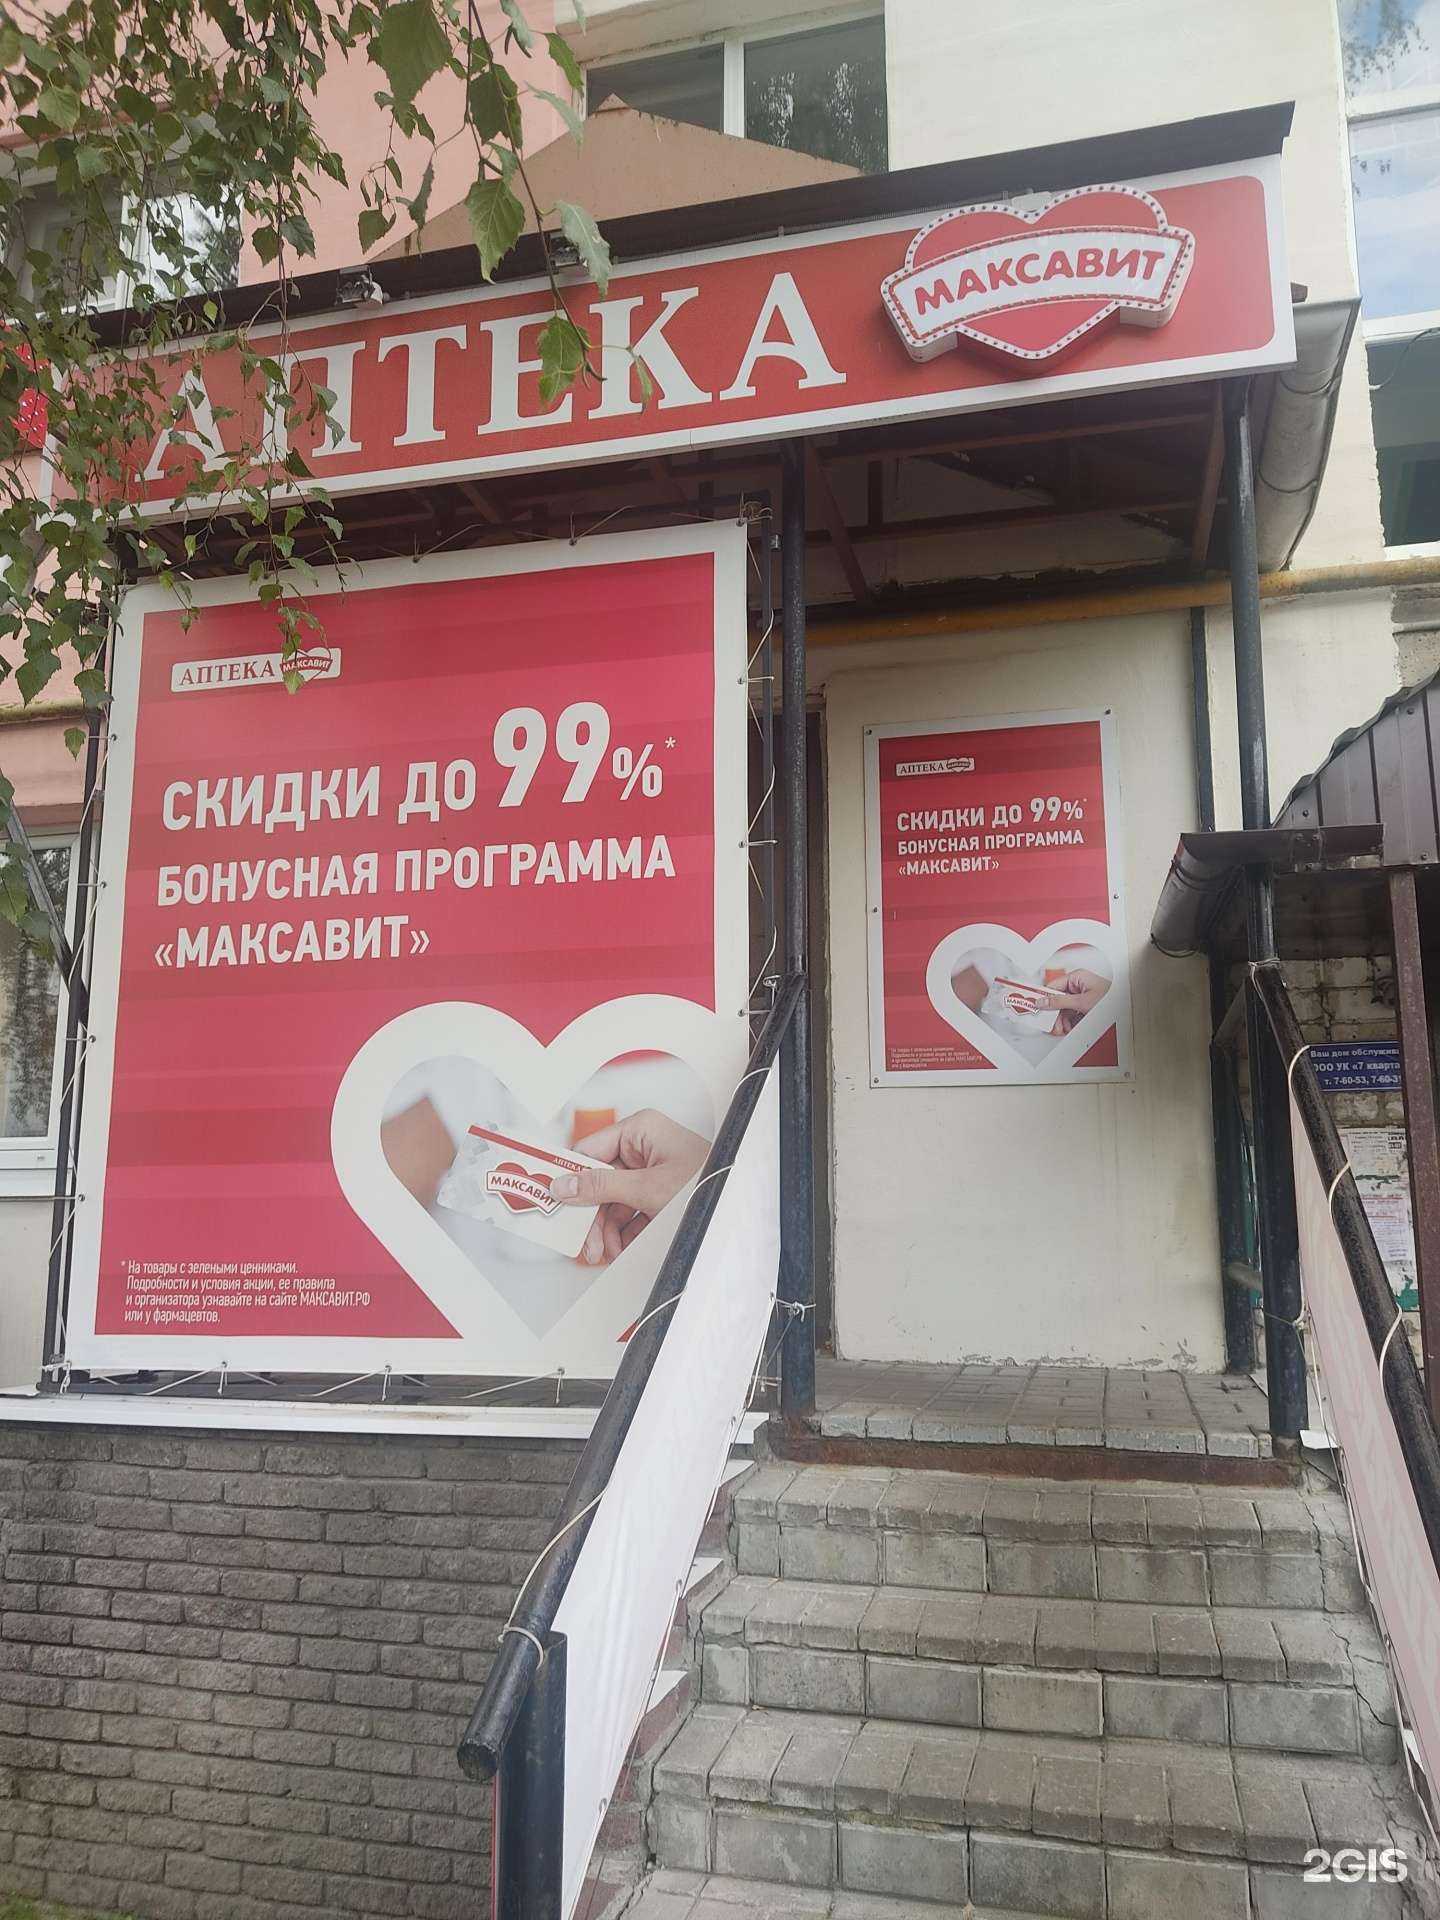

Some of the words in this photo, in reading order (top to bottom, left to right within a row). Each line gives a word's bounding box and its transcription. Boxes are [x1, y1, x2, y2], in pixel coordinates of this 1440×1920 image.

[913, 246, 1166, 316] МАКСАВИТ
[135, 271, 847, 483] АПТЕКА
[179, 660, 276, 686] АПТЕКА
[900, 763, 944, 774] АПТЕКА
[162, 765, 381, 833] СКИДКИ
[397, 759, 477, 824] ДО
[897, 807, 985, 833] СКИДКИ
[991, 805, 1022, 829] ДО
[897, 836, 980, 856] БОНУСНАЯ
[984, 829, 1084, 850] ПРОГРАММА
[157, 852, 379, 906] БОНУСНАЯ
[395, 834, 677, 892] ПРОГРАММА
[898, 856, 1000, 876] «МАКСАВИТ»
[154, 915, 431, 969] «МАКСАВИТ»
[1310, 1050, 1330, 1058] Ваш
[1336, 1062, 1350, 1071] УК
[553, 1158, 582, 1173] АПТЕКА
[128, 1260, 141, 1273] На
[143, 1261, 178, 1277] товары
[179, 1262, 186, 1274] с
[187, 1261, 238, 1274] зелеными
[240, 1262, 298, 1275] ценниками.
[127, 1275, 189, 1292] Подробности
[191, 1279, 198, 1290] и
[200, 1278, 241, 1293] условия
[243, 1278, 276, 1292] акции,
[278, 1278, 291, 1290] ее
[293, 1278, 336, 1293] правила
[125, 1294, 132, 1306] и
[134, 1294, 200, 1308] организатора
[201, 1292, 252, 1309] узнавайте
[254, 1294, 267, 1306] на
[269, 1291, 298, 1306] сайте
[299, 1290, 371, 1306] МАКСАВИТ.РФ
[124, 1310, 143, 1322] или
[145, 1310, 152, 1324] у
[153, 1307, 221, 1324] фармацевтов.
